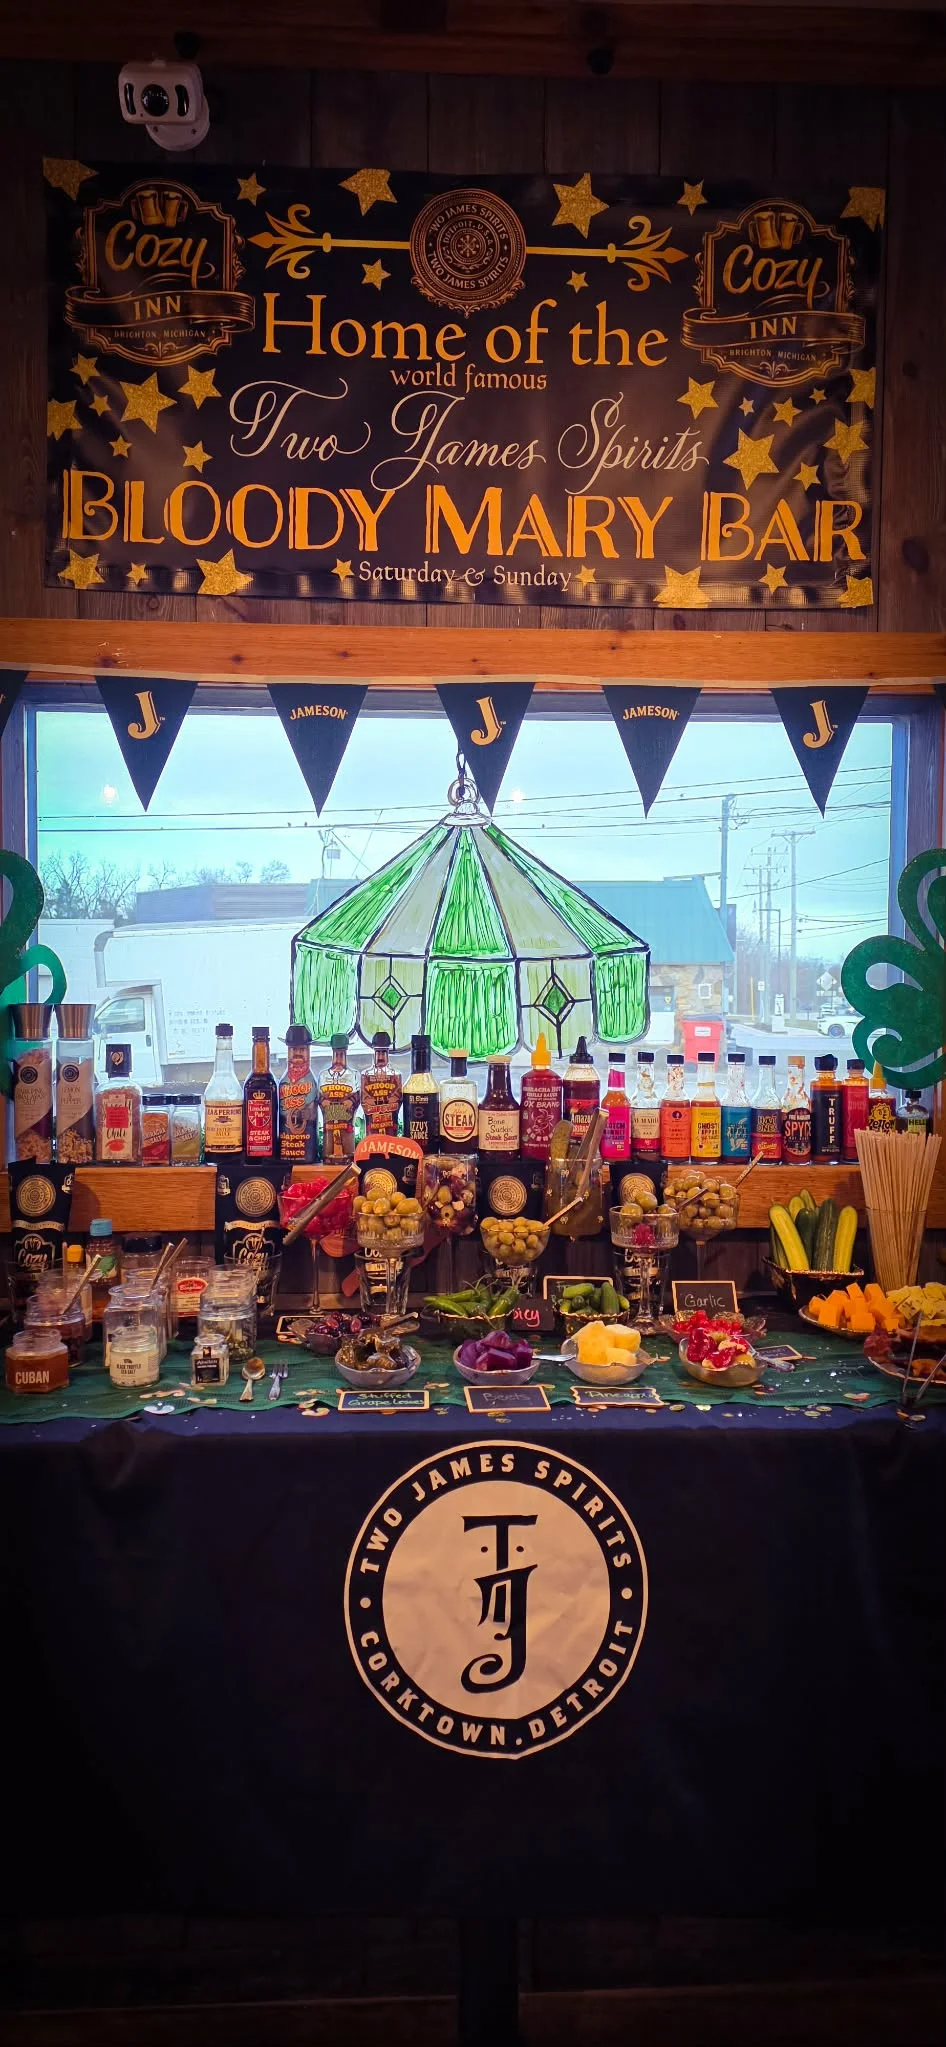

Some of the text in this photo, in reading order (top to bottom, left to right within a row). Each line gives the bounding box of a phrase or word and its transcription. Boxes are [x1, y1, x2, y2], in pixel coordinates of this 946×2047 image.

[445, 204, 477, 218] JAMES
[479, 207, 509, 240] SPIRITS
[105, 219, 215, 290] Cozy
[427, 251, 510, 289] TWO JAMES SPIRITS
[723, 244, 830, 310] Cozy
[133, 295, 182, 321] INN
[162, 328, 206, 340] MICHIGAN
[263, 292, 669, 367] Home of the
[749, 316, 798, 340] INN
[776, 350, 818, 362] MICHIGAN
[389, 362, 548, 394] world famous
[229, 377, 711, 496] Two James Spirits
[62, 468, 867, 563] BLOODY MARY BAR
[358, 560, 572, 592] Saturday & Sunday
[289, 704, 347, 720] JAMESON
[622, 705, 678, 721] JAMESON
[320, 1084, 358, 1093] WHOOP
[365, 1082, 396, 1092] WHOOP
[445, 1113, 473, 1127] STEAK
[487, 1116, 505, 1125] Bone
[828, 1098, 836, 1144] TRUFF
[281, 1140, 305, 1148] Steak
[410, 1131, 429, 1140] SAUCE
[281, 1148, 306, 1156] Sauce
[360, 1140, 420, 1160] JAMESON
[684, 1293, 726, 1308] Garlic
[15, 1370, 50, 1385] CUBAN
[348, 1399, 391, 1407] Grape
[360, 1453, 632, 1576] TWO JAMES SPIRITS
